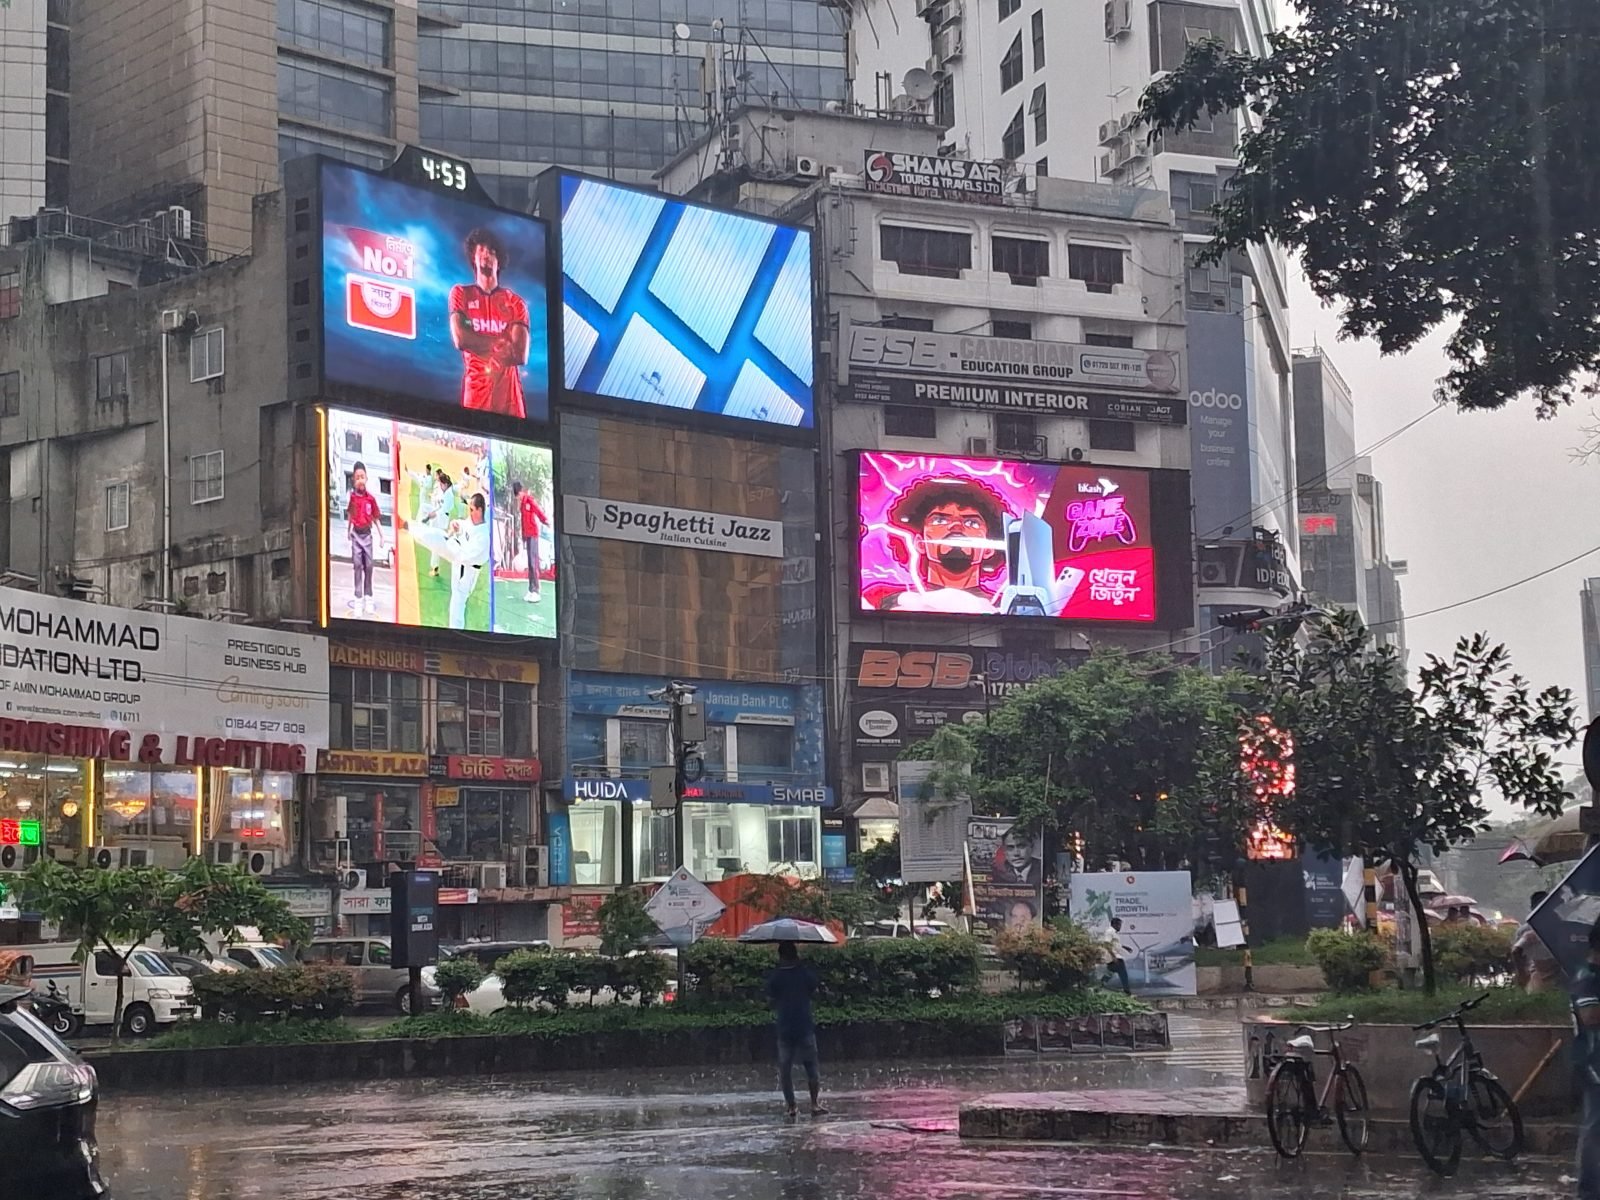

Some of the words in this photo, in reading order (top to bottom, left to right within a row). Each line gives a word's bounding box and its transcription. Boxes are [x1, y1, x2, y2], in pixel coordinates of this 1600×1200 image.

[422, 157, 467, 190] 4:53
[892, 154, 966, 178] SHAMS
[968, 163, 1002, 182] AIR
[899, 173, 931, 186] TOURS
[932, 176, 940, 187] &
[940, 178, 982, 192] TRAVELS
[983, 182, 1000, 194] LTD
[364, 246, 414, 279] No.1
[850, 331, 941, 369] BSB
[959, 337, 1074, 366] CAMBRIAN
[961, 360, 1029, 375] EDUCATION
[1033, 365, 1074, 379] GROUP
[914, 383, 1003, 404] PREMIUM
[1005, 390, 1089, 410] INTERIOR
[1189, 388, 1242, 410] odoo
[1200, 415, 1232, 427] Manage
[1208, 429, 1226, 440] your
[1200, 443, 1236, 454] business
[1078, 483, 1102, 494] bKash
[603, 504, 715, 535] Spaghetti
[721, 519, 772, 542] Jazz
[660, 532, 692, 544] Italian
[694, 536, 728, 548] Cuisine
[1089, 568, 1136, 587] খেলুন
[1256, 567, 1275, 584] IDP
[1090, 584, 1141, 606] জিতুন
[0, 605, 160, 651] MOHAMMAD
[227, 639, 302, 658] PRESTIGIOUS
[224, 655, 281, 671] BUSINESS
[283, 663, 307, 674] HUB
[379, 650, 417, 669] SUPER
[97, 657, 146, 683] LTD.
[857, 650, 973, 689] BSB
[13, 682, 37, 694] AMIN
[39, 685, 101, 701] MOHAMMAD
[103, 692, 141, 704] GROUP
[706, 691, 738, 706] Janata
[741, 693, 766, 708] Bank
[225, 718, 258, 730] 01844
[260, 720, 280, 732] 527
[139, 734, 163, 766] &
[175, 736, 307, 772] LIGHTING
[382, 757, 427, 775] PLAZA
[575, 781, 628, 799] HUIDA
[773, 787, 826, 802] SMAB
